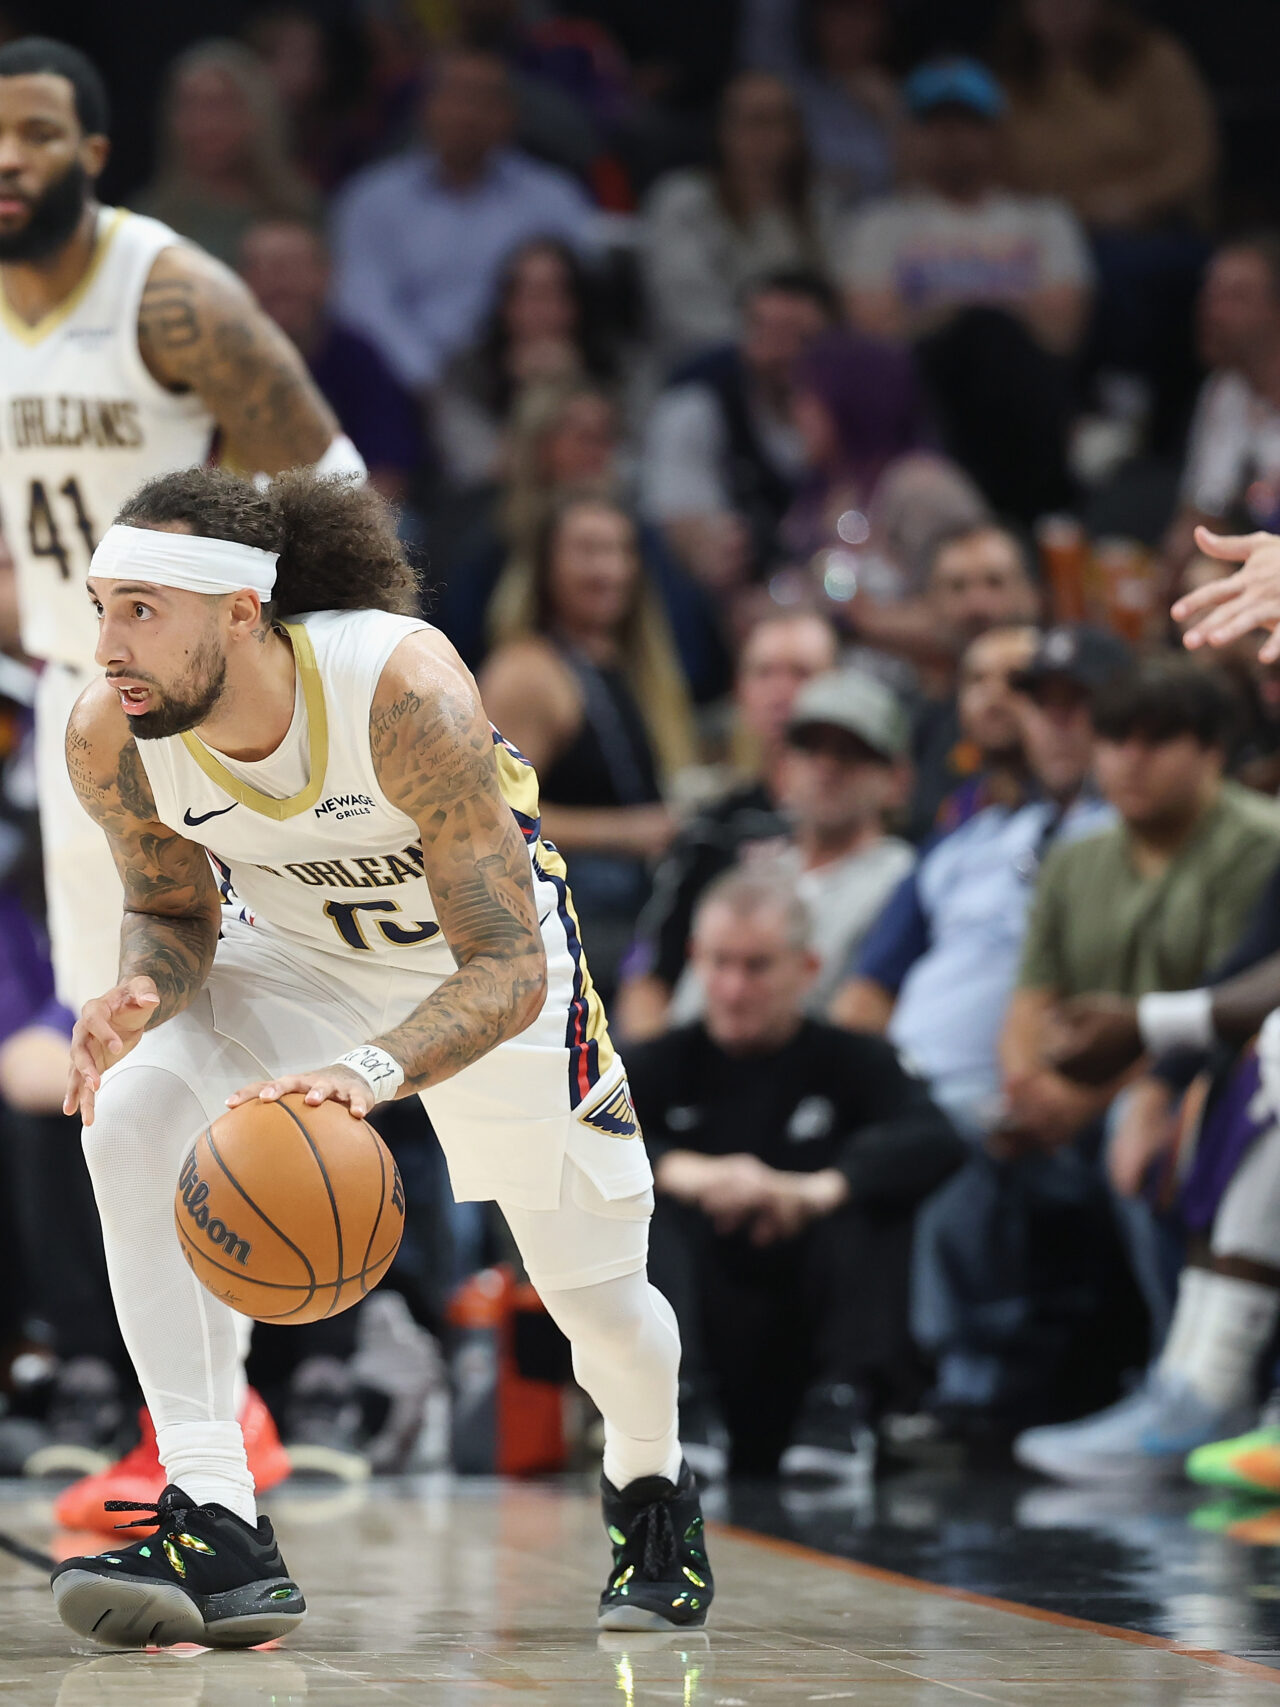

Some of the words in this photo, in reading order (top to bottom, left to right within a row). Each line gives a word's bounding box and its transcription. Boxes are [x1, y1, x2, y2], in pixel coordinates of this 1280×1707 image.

[27, 475, 97, 580] 41
[314, 793, 376, 819] NEWAGE
[335, 807, 371, 820] GRILLS
[178, 1146, 252, 1266] Wilson
